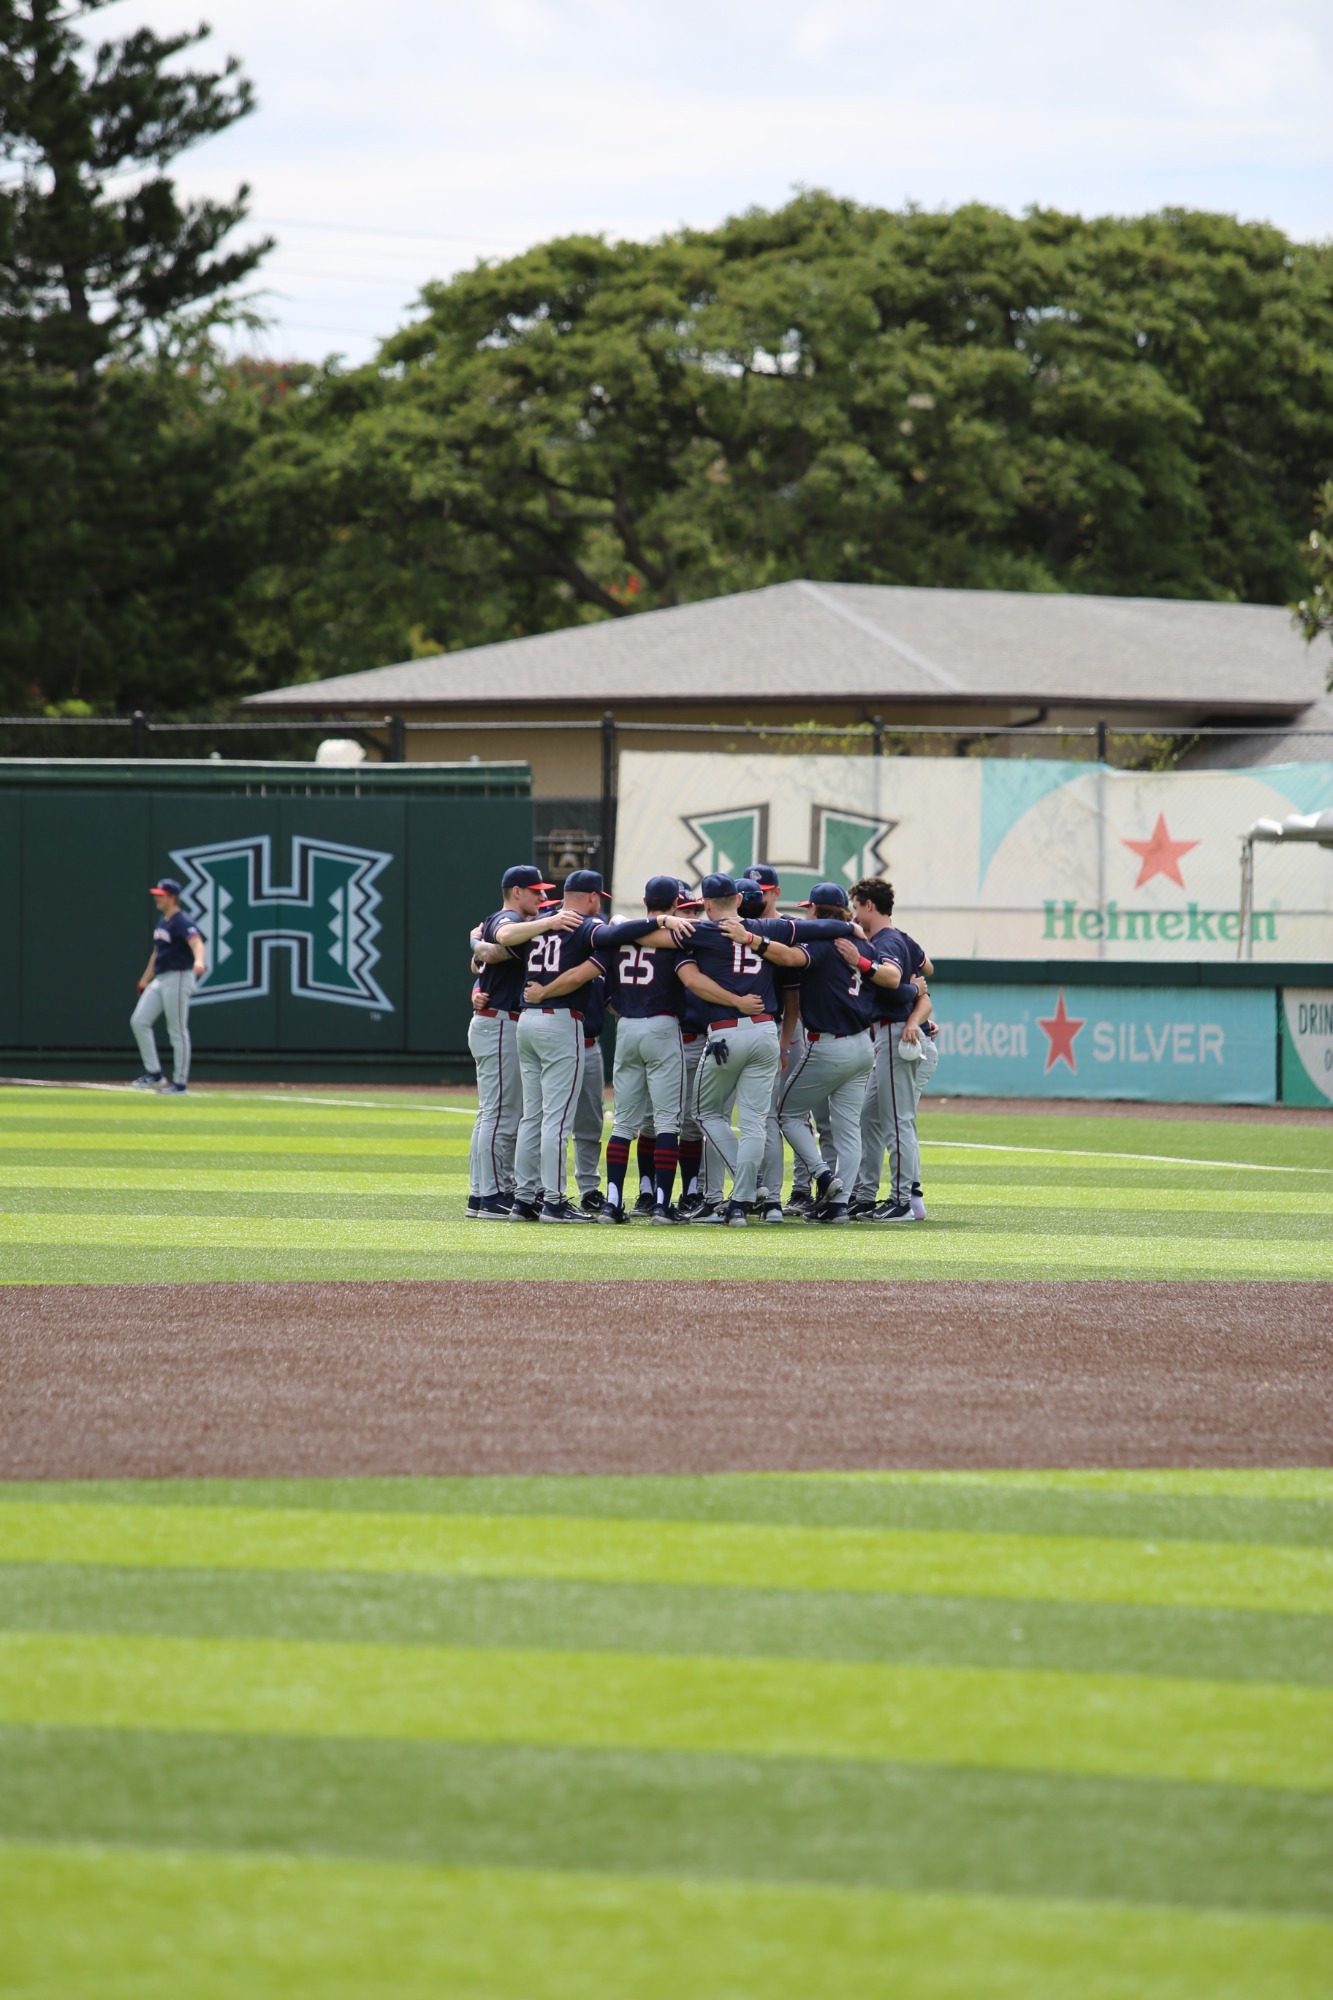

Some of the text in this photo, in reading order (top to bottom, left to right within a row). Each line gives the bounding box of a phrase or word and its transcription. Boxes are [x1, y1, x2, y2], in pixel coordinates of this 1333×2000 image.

[1042, 900, 1278, 942] Heineken
[527, 935, 562, 972] 20
[618, 945, 657, 985] 25
[732, 941, 763, 975] 15
[936, 1012, 1225, 1065] neken SILVER
